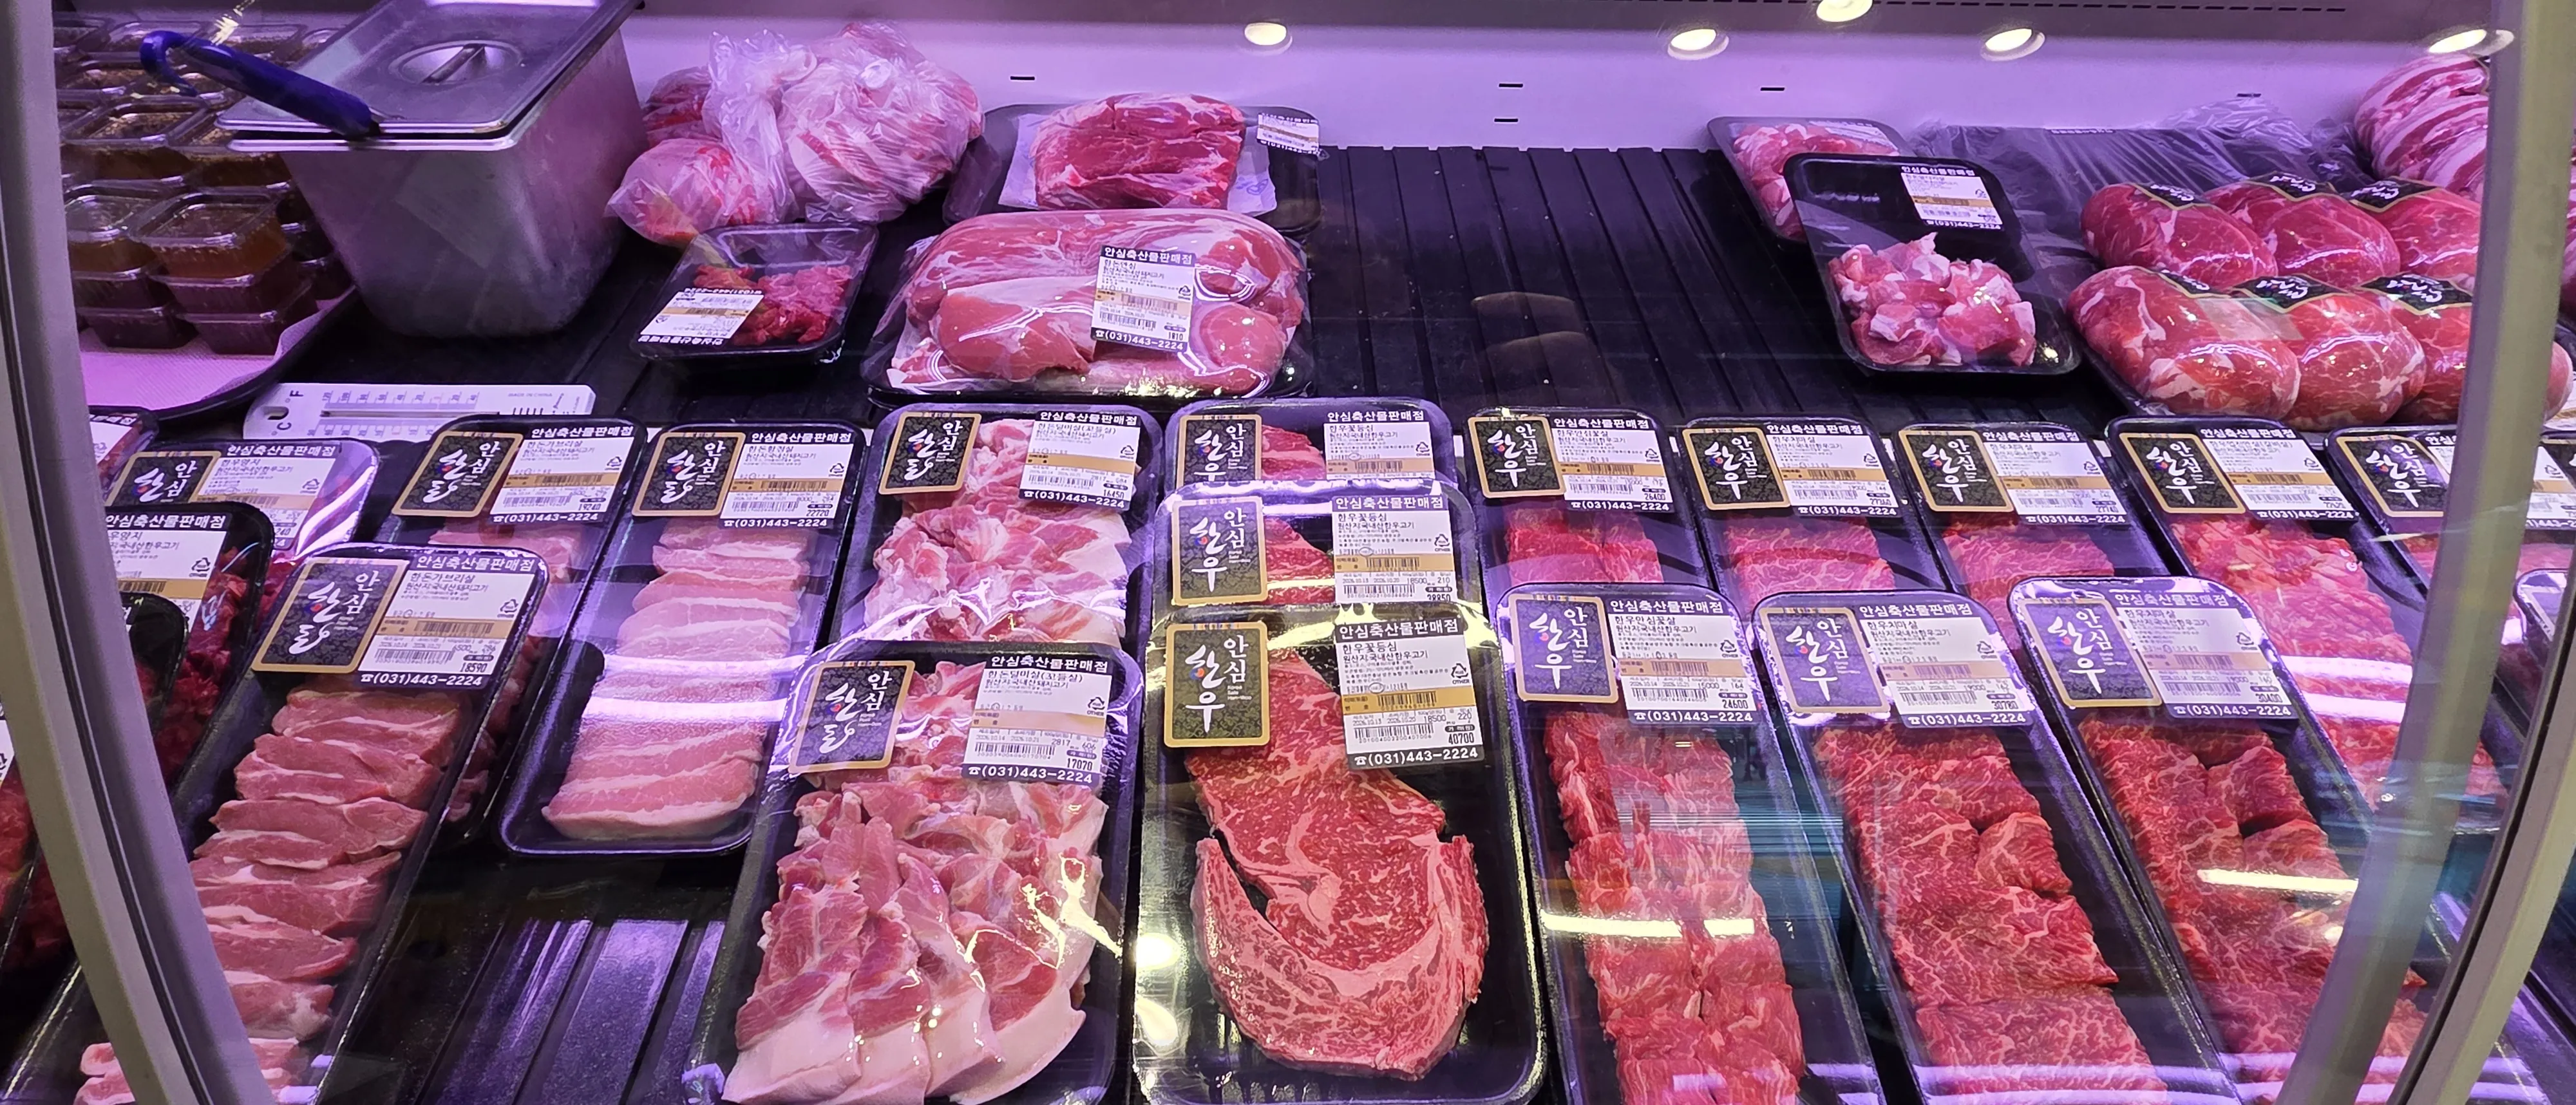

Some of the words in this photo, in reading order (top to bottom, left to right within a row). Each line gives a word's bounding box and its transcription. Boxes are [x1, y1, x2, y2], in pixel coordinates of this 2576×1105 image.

[1104, 247, 1192, 265] 안심축산물판매점
[1105, 332, 1184, 350] (031)443-2224
[1040, 411, 1137, 426] 안심축산물판매점
[1327, 410, 1425, 422] 안심축산물판매점
[1554, 418, 1649, 429] 안심축산물판매점
[1766, 424, 1863, 435] 안심축산물판매점
[532, 426, 634, 438] 안심축산물판매점
[752, 433, 852, 443] 안심축산물판매점
[938, 420, 963, 451] 안심
[1982, 431, 2080, 442] 안심축산물판매점
[2200, 429, 2297, 439] 안심축산물판매점
[1226, 423, 1247, 458] 안심
[1515, 423, 1539, 456] 안심
[227, 445, 337, 457] 안심축산물판매점
[469, 441, 500, 474] 안심
[698, 440, 726, 473] 안심
[1731, 435, 1757, 468] 안심
[1947, 439, 1977, 471] 안심
[2170, 441, 2203, 474] 안심
[2391, 442, 2424, 475] 안심
[164, 461, 198, 498] 안심
[1035, 490, 1125, 508] (031)443-2224
[1103, 489, 1124, 499] 16450
[1336, 496, 1443, 509] 안심축산물판매점
[1582, 502, 1669, 511] (031)443-2224
[1809, 506, 1897, 515] (031)443-2224
[104, 514, 227, 529] 안심축산물판매점
[504, 513, 598, 522] (031)443-2224
[735, 518, 828, 527] (031)443-2224
[1338, 513, 1387, 522] 한우꽃등심
[1224, 507, 1249, 550] 안심
[109, 531, 143, 541] 우양지
[416, 555, 535, 571] 안심축산물판매점
[410, 573, 476, 583] 한돈가브리살
[345, 571, 381, 615] 안심
[1610, 600, 1723, 614] 안심축산물판매점
[2115, 594, 2229, 607] 안심축산물판매점
[1859, 603, 1973, 618] 안심축산물판매점
[2125, 610, 2177, 618] 한우치마살
[1615, 616, 1676, 625] 한우안심꽃살
[1867, 621, 1919, 630] 한우치마살
[1340, 619, 1459, 639] 안심축산물판매점
[1564, 607, 1589, 649] 안심
[2077, 608, 2111, 650] 안심
[1817, 618, 1848, 659] 안심
[1342, 641, 1398, 655] 한우꽃등심
[991, 655, 1108, 673] 안심축산물판매점
[1224, 634, 1249, 683] 안심
[459, 663, 488, 672] 18590
[373, 673, 483, 686] (031)443-2224
[860, 671, 892, 710] 안심
[1722, 699, 1748, 709] 24600
[1991, 701, 2018, 710] 30780
[2187, 705, 2291, 716] (031)443-2224
[1424, 715, 1446, 723] 18500
[1648, 711, 1753, 722] (031)443-2224
[1922, 713, 2026, 725] (031)443-2224
[1051, 739, 1070, 747] 2817
[1448, 733, 1474, 744] 40700
[1368, 748, 1478, 766] (031)443-2224
[1067, 758, 1093, 771] 17070
[982, 766, 1092, 784] (031)443-2224
